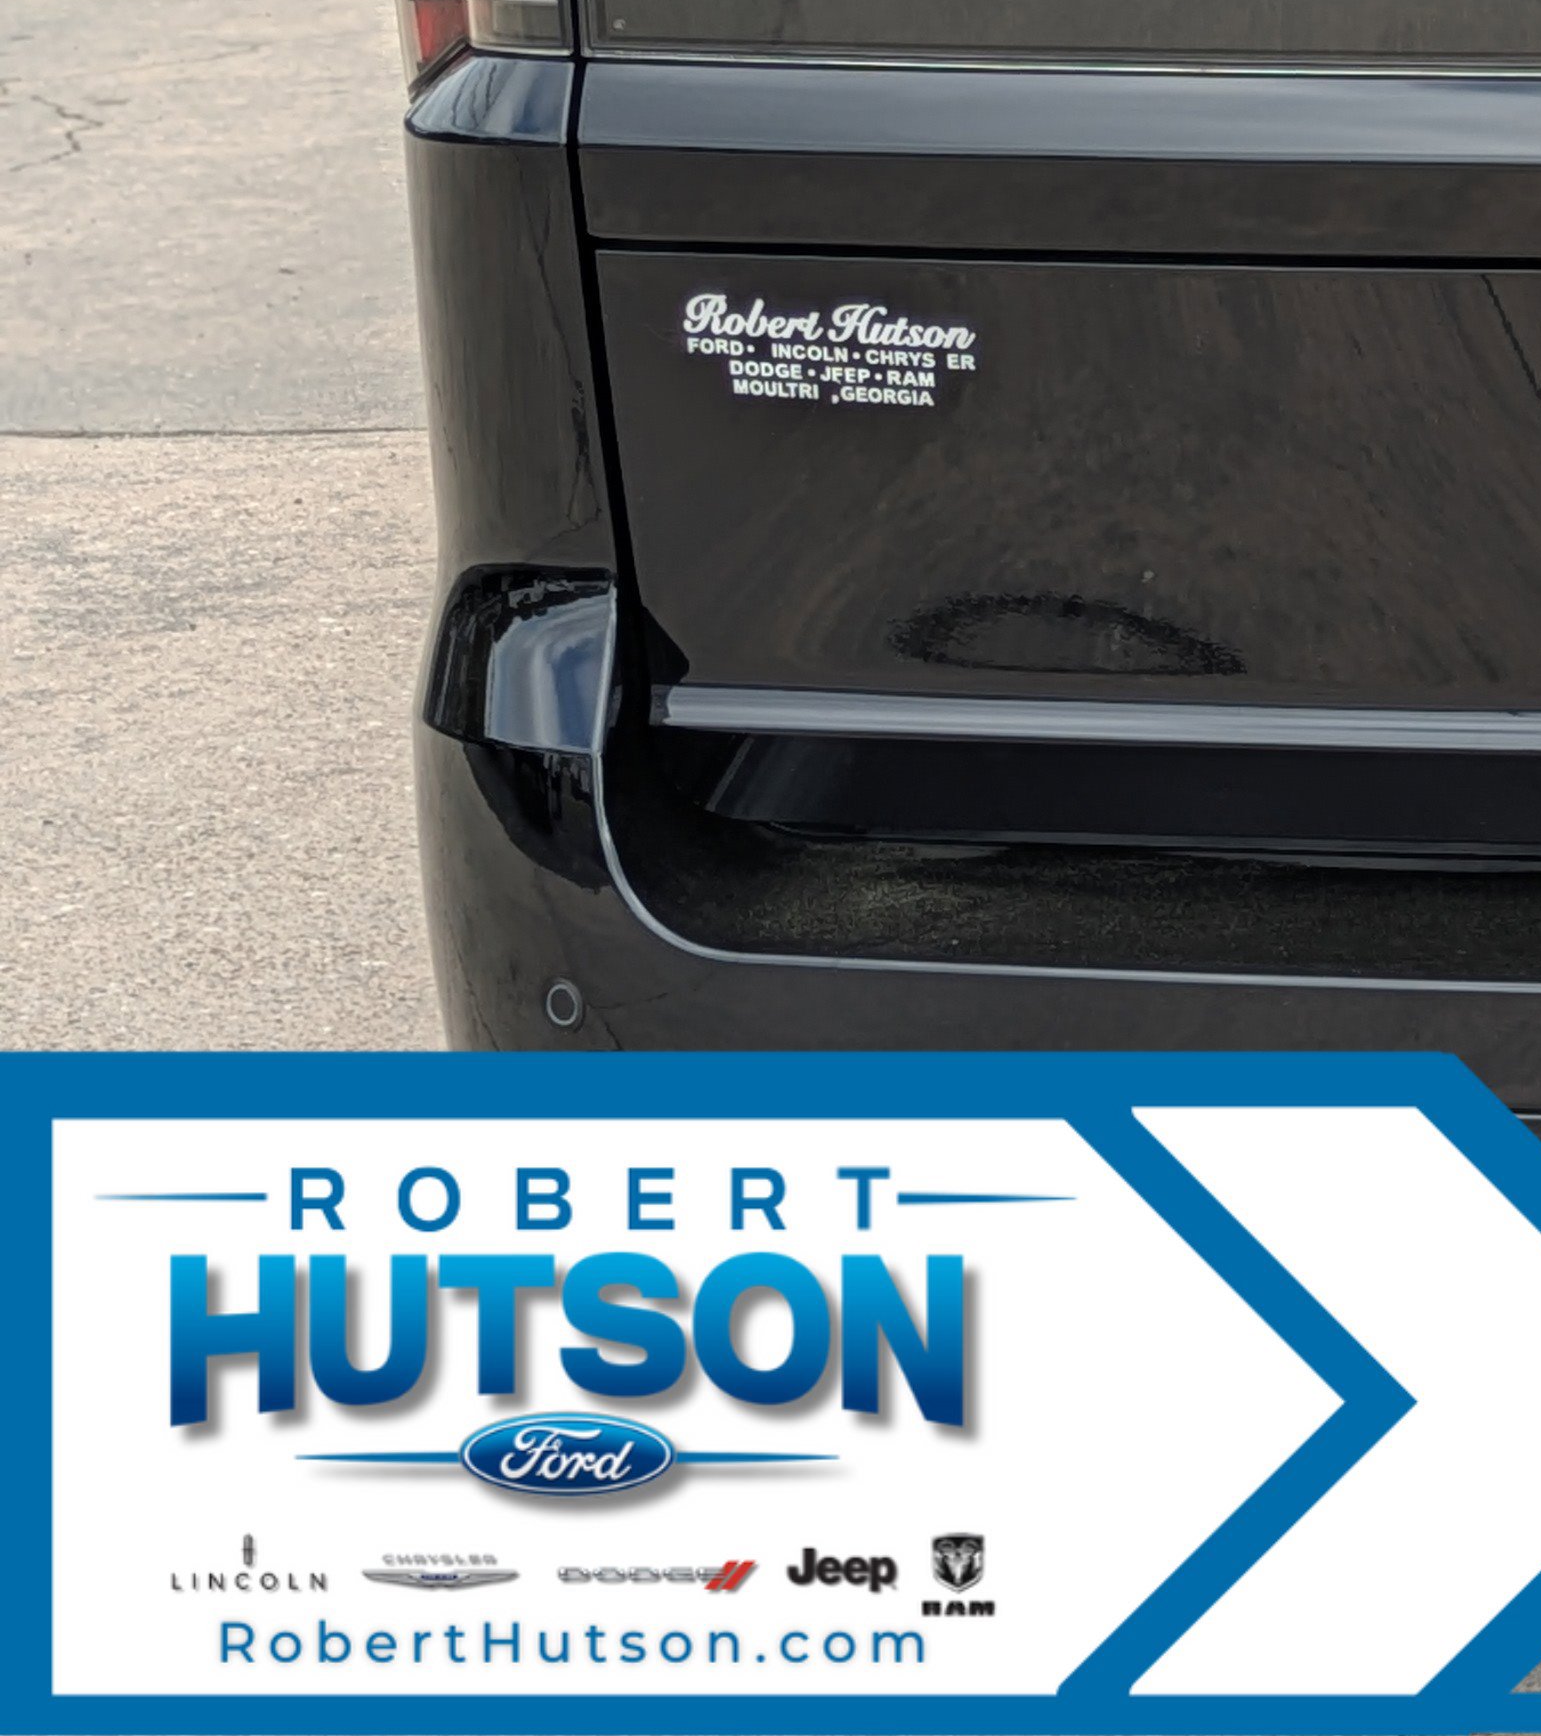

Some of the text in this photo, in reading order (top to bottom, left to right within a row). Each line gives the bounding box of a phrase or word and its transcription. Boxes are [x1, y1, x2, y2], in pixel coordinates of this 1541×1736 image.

[682, 293, 976, 350] Robert Hutson
[728, 360, 803, 380] DODGE
[887, 370, 935, 387] RAM
[865, 349, 976, 371] CHRYSER
